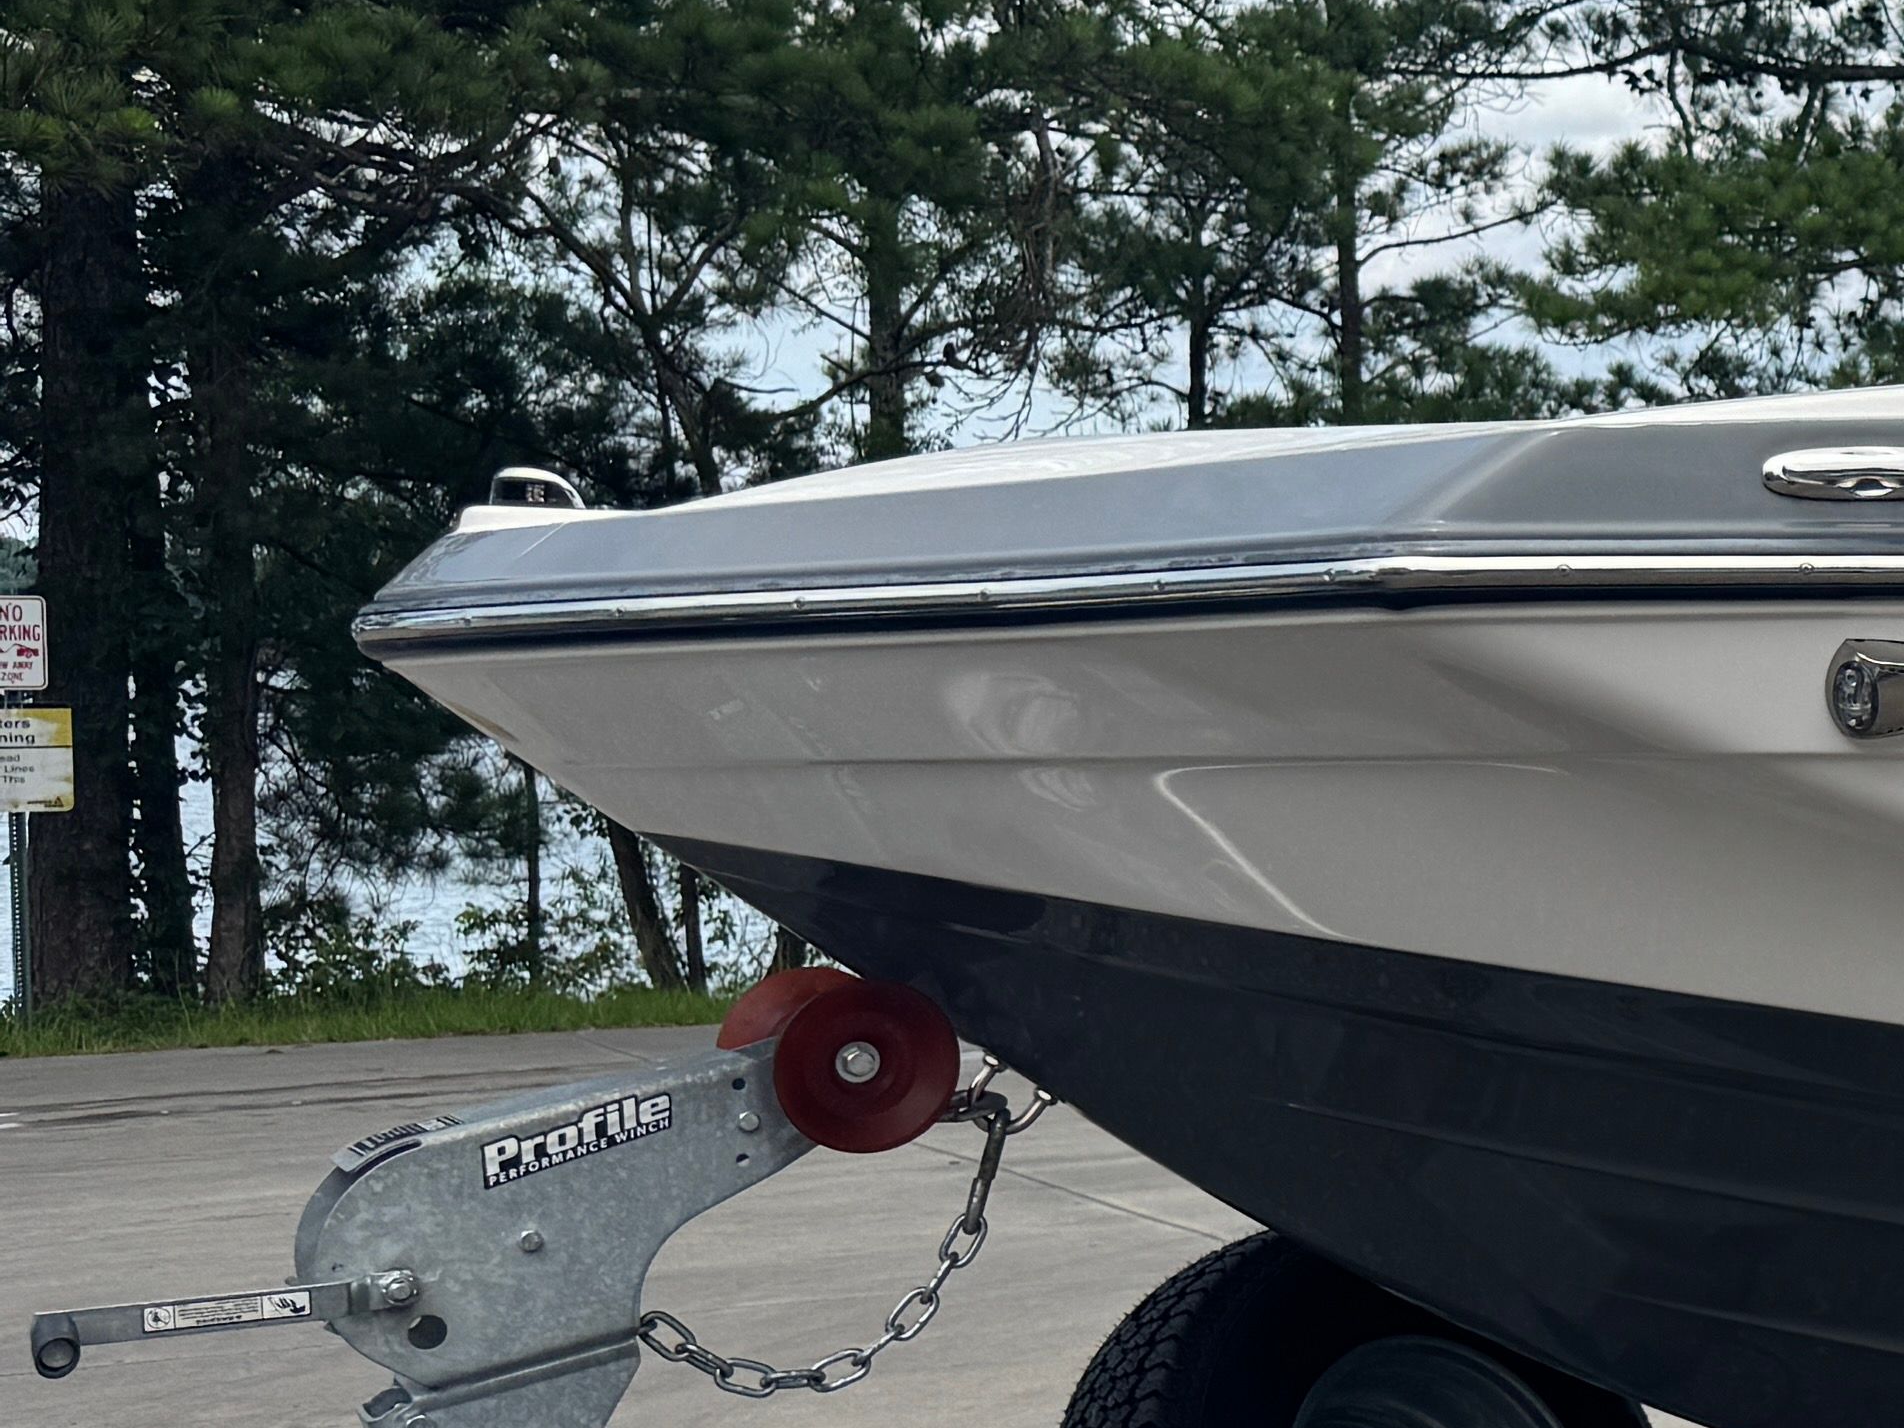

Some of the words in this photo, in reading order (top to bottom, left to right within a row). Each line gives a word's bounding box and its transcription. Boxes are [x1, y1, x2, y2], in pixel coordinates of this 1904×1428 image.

[0, 604, 23, 622] NO
[0, 624, 41, 642] RKING
[0, 731, 36, 745] ning
[483, 1094, 671, 1177] Profile
[488, 1138, 609, 1187] PERFORMANCE
[614, 1117, 670, 1144] WINCH
